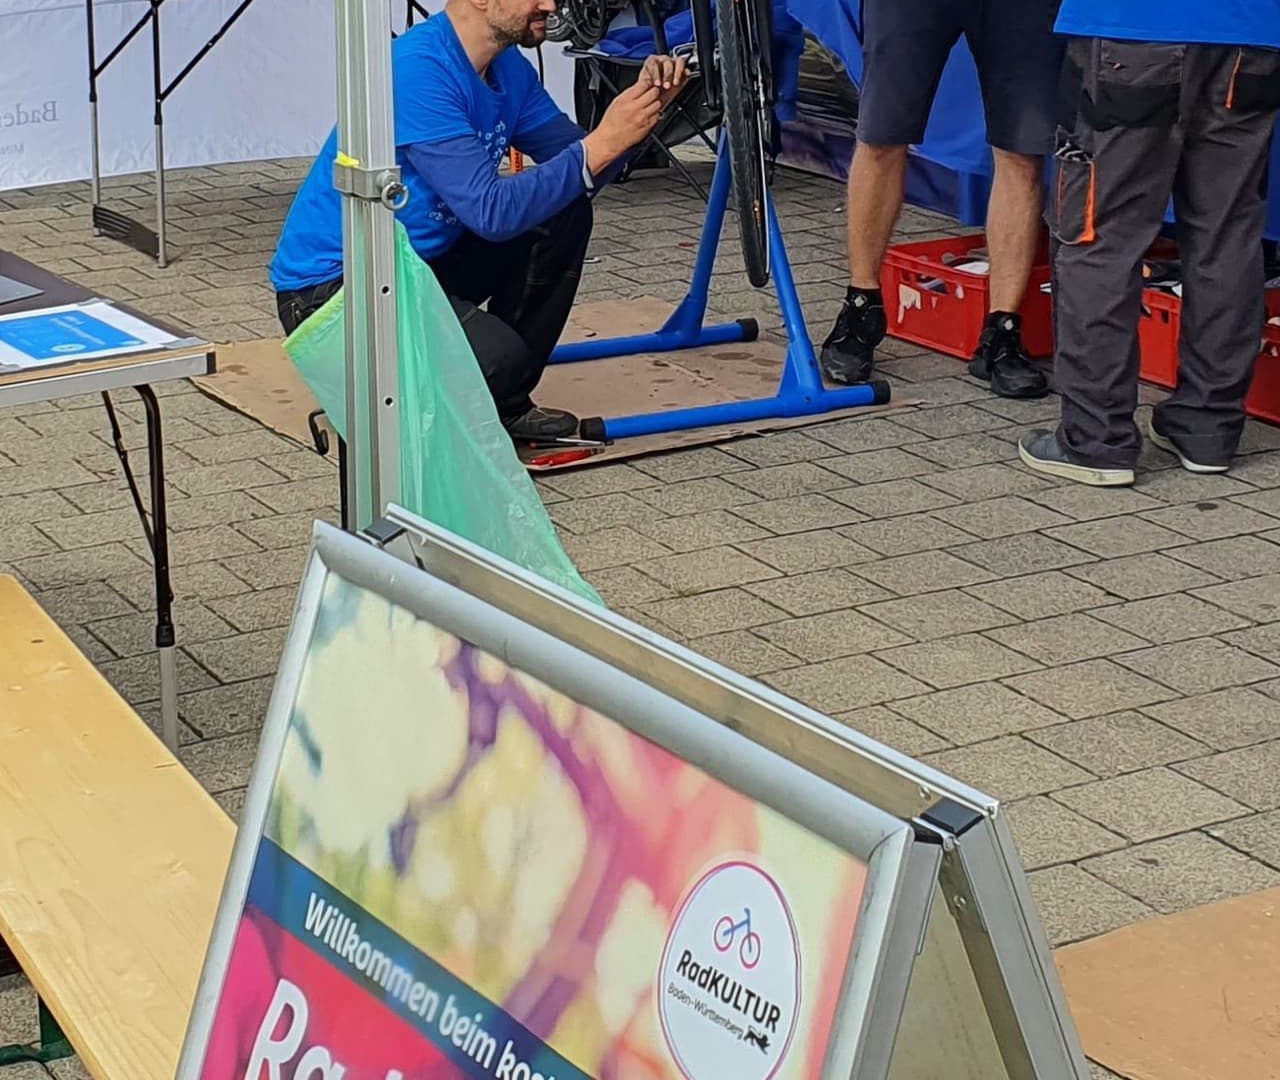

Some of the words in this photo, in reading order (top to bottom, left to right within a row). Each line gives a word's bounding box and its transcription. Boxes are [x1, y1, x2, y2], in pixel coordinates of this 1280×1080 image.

[303, 892, 441, 1023] Willkommen
[438, 994, 497, 1070] beim
[676, 949, 781, 1035] RadKULTUR
